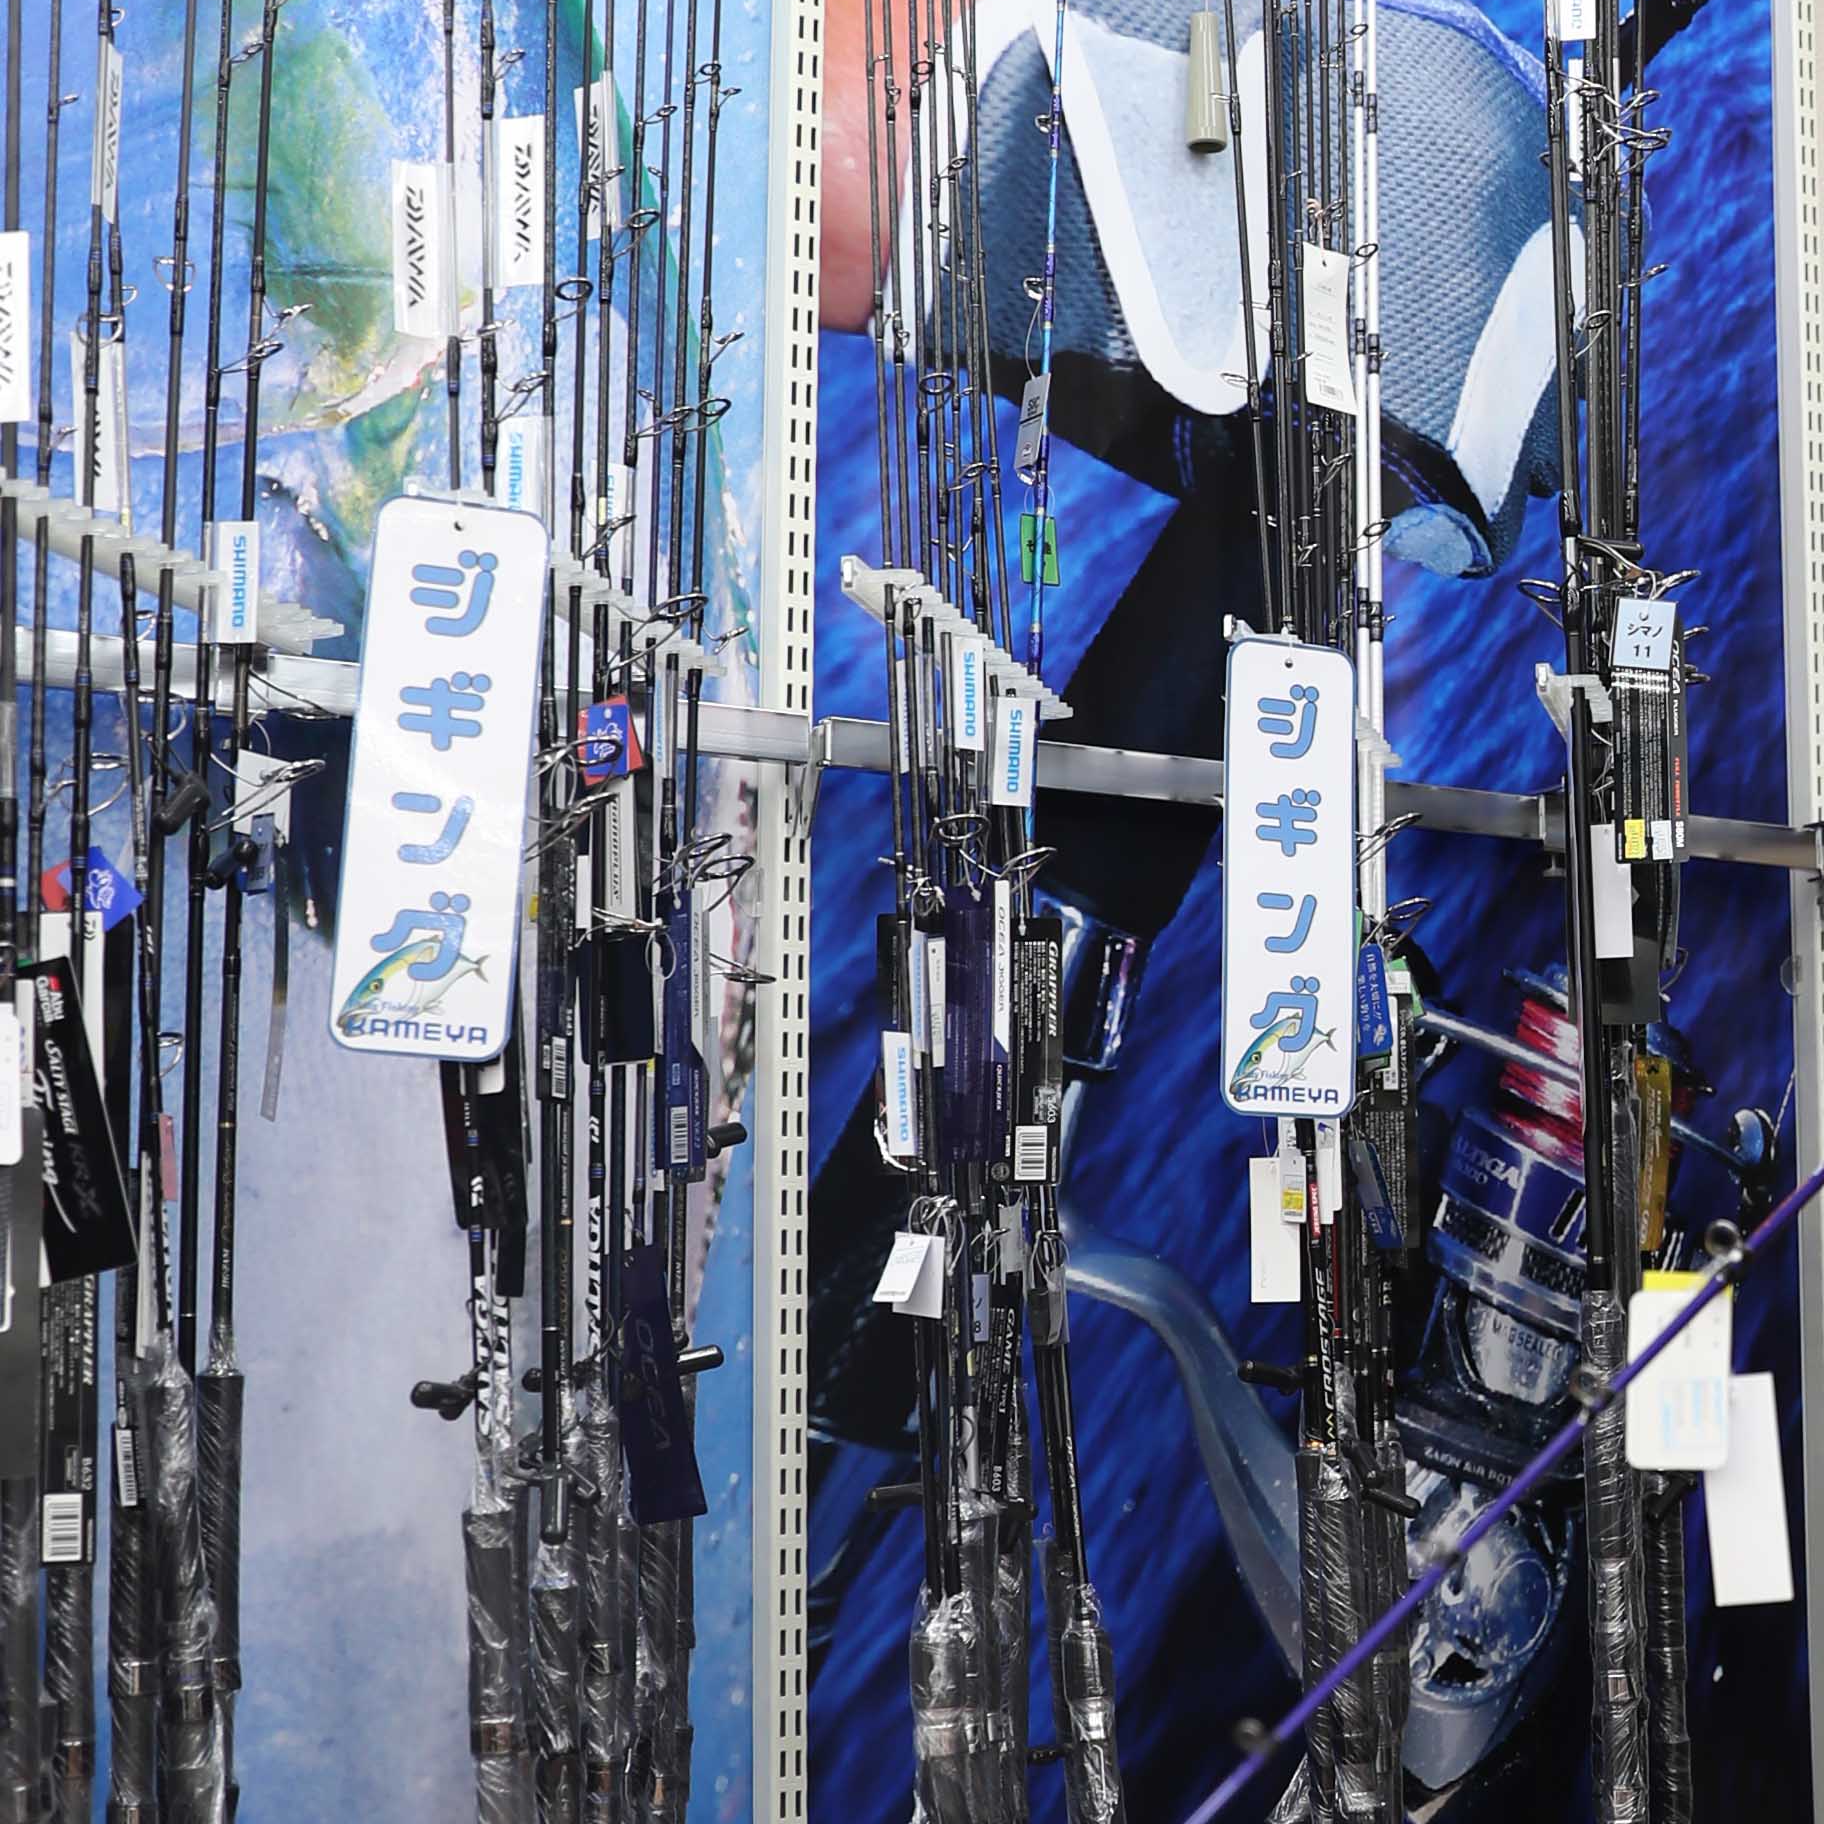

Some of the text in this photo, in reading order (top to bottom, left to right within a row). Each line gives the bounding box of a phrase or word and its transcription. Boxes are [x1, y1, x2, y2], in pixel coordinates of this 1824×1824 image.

[404, 186, 428, 309] DAIWA
[511, 140, 534, 264] DAIWA
[231, 534, 248, 630] SHIMANO
[1626, 623, 1664, 638] シマノ
[1632, 643, 1652, 658] 11
[965, 650, 976, 739] SHIMANO
[369, 549, 499, 983] ジギング
[1007, 708, 1023, 794] SHIMANO
[1249, 683, 1322, 1053] ジギング
[35, 976, 51, 1024] Garcia
[49, 991, 65, 1021] Abu
[345, 1016, 489, 1047] KAMEYA
[1047, 939, 1059, 1038] GRAPPLER
[44, 1039, 79, 1136] SALTY STAGE
[897, 1045, 909, 1143] SHIMANO
[1236, 1083, 1340, 1106] KAMEYA
[1001, 1307, 1016, 1375] GAME
[1313, 1266, 1335, 1411] CROSTAGE
